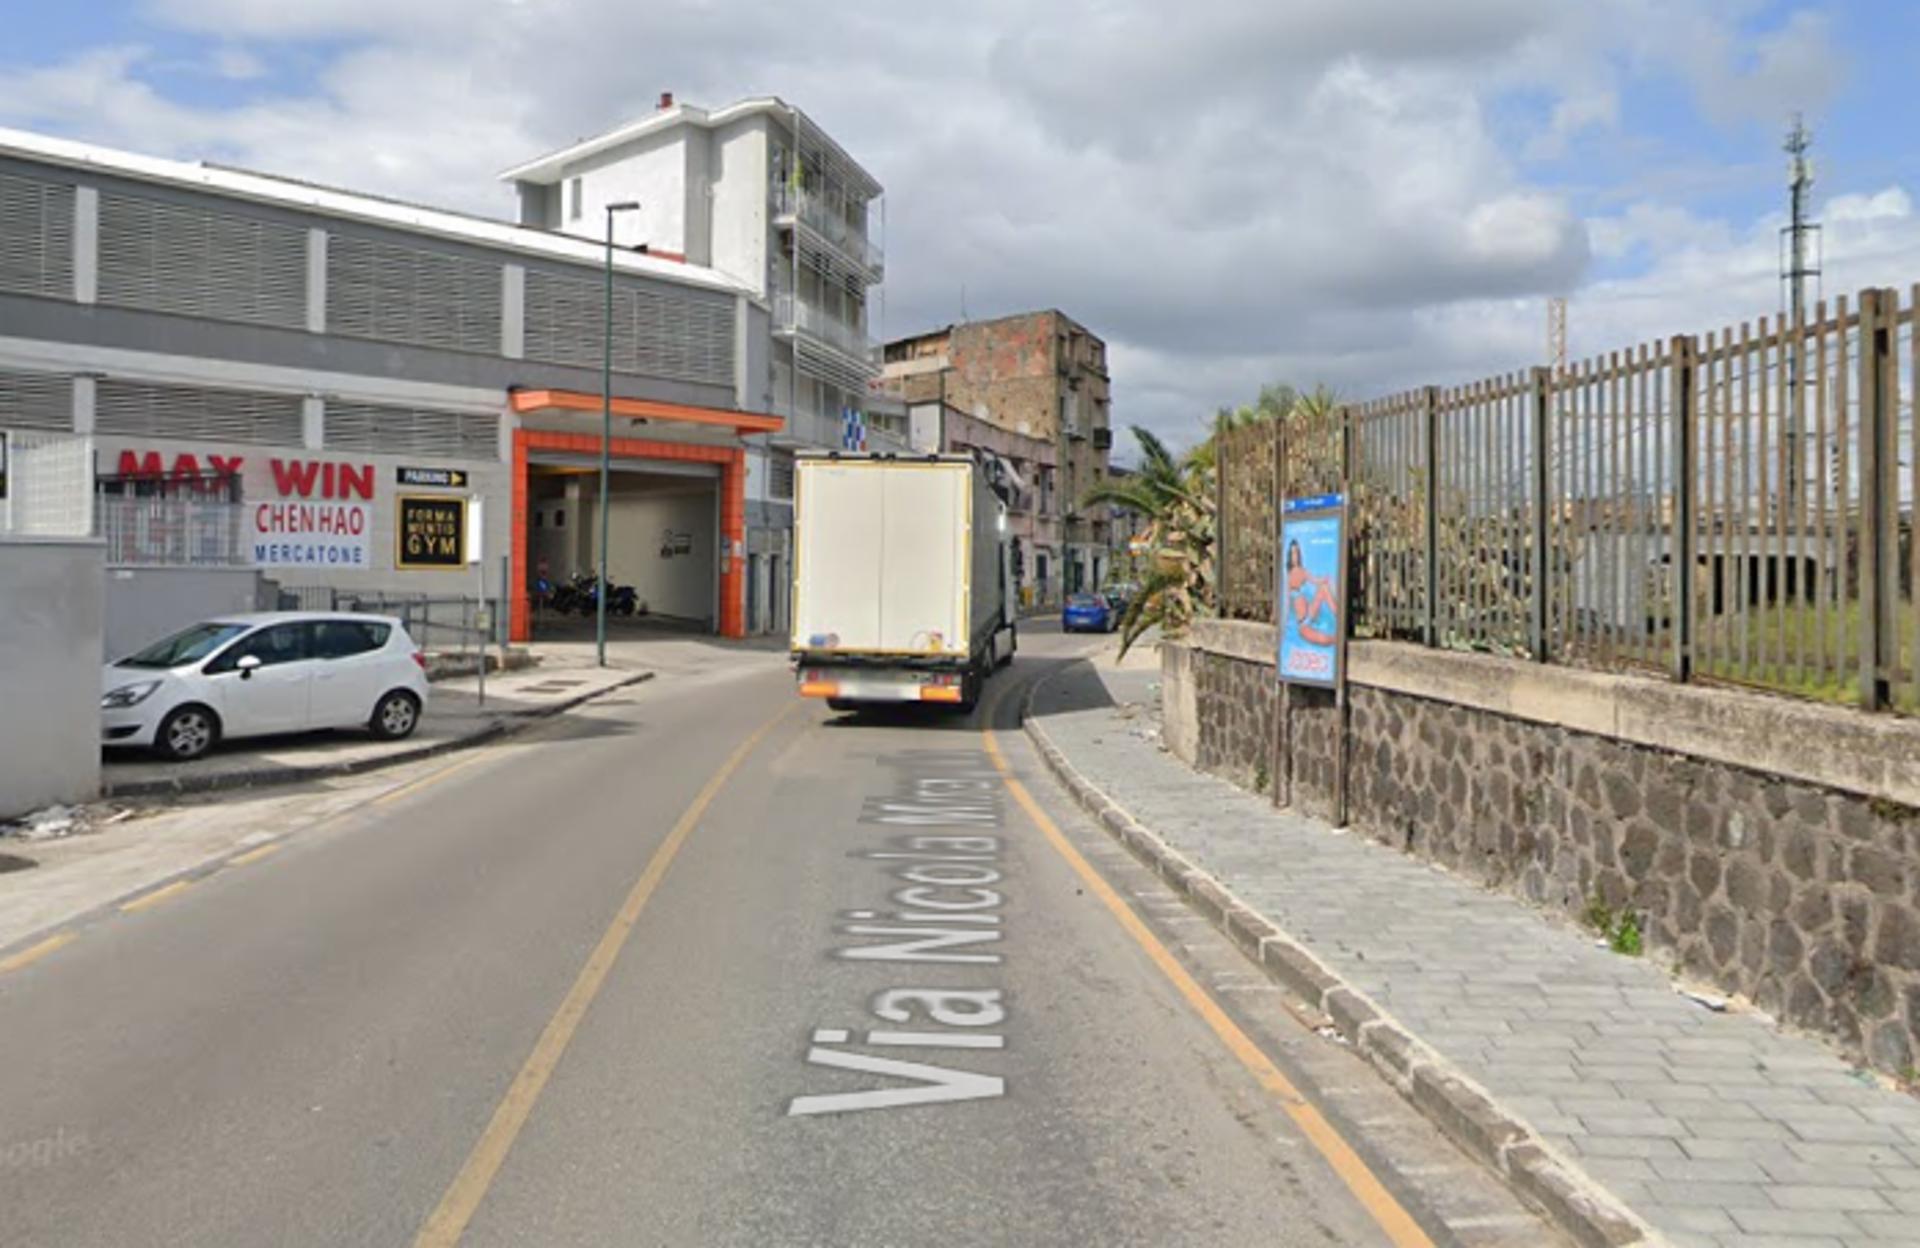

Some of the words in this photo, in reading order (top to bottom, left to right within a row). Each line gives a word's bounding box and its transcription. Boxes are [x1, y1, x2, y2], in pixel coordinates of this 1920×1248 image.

[118, 449, 243, 495] MAX
[270, 458, 374, 500] WIN
[405, 470, 449, 484] PARKING
[407, 509, 456, 522] FORMA
[255, 544, 363, 563] MERCATONE
[407, 534, 456, 555] GYM
